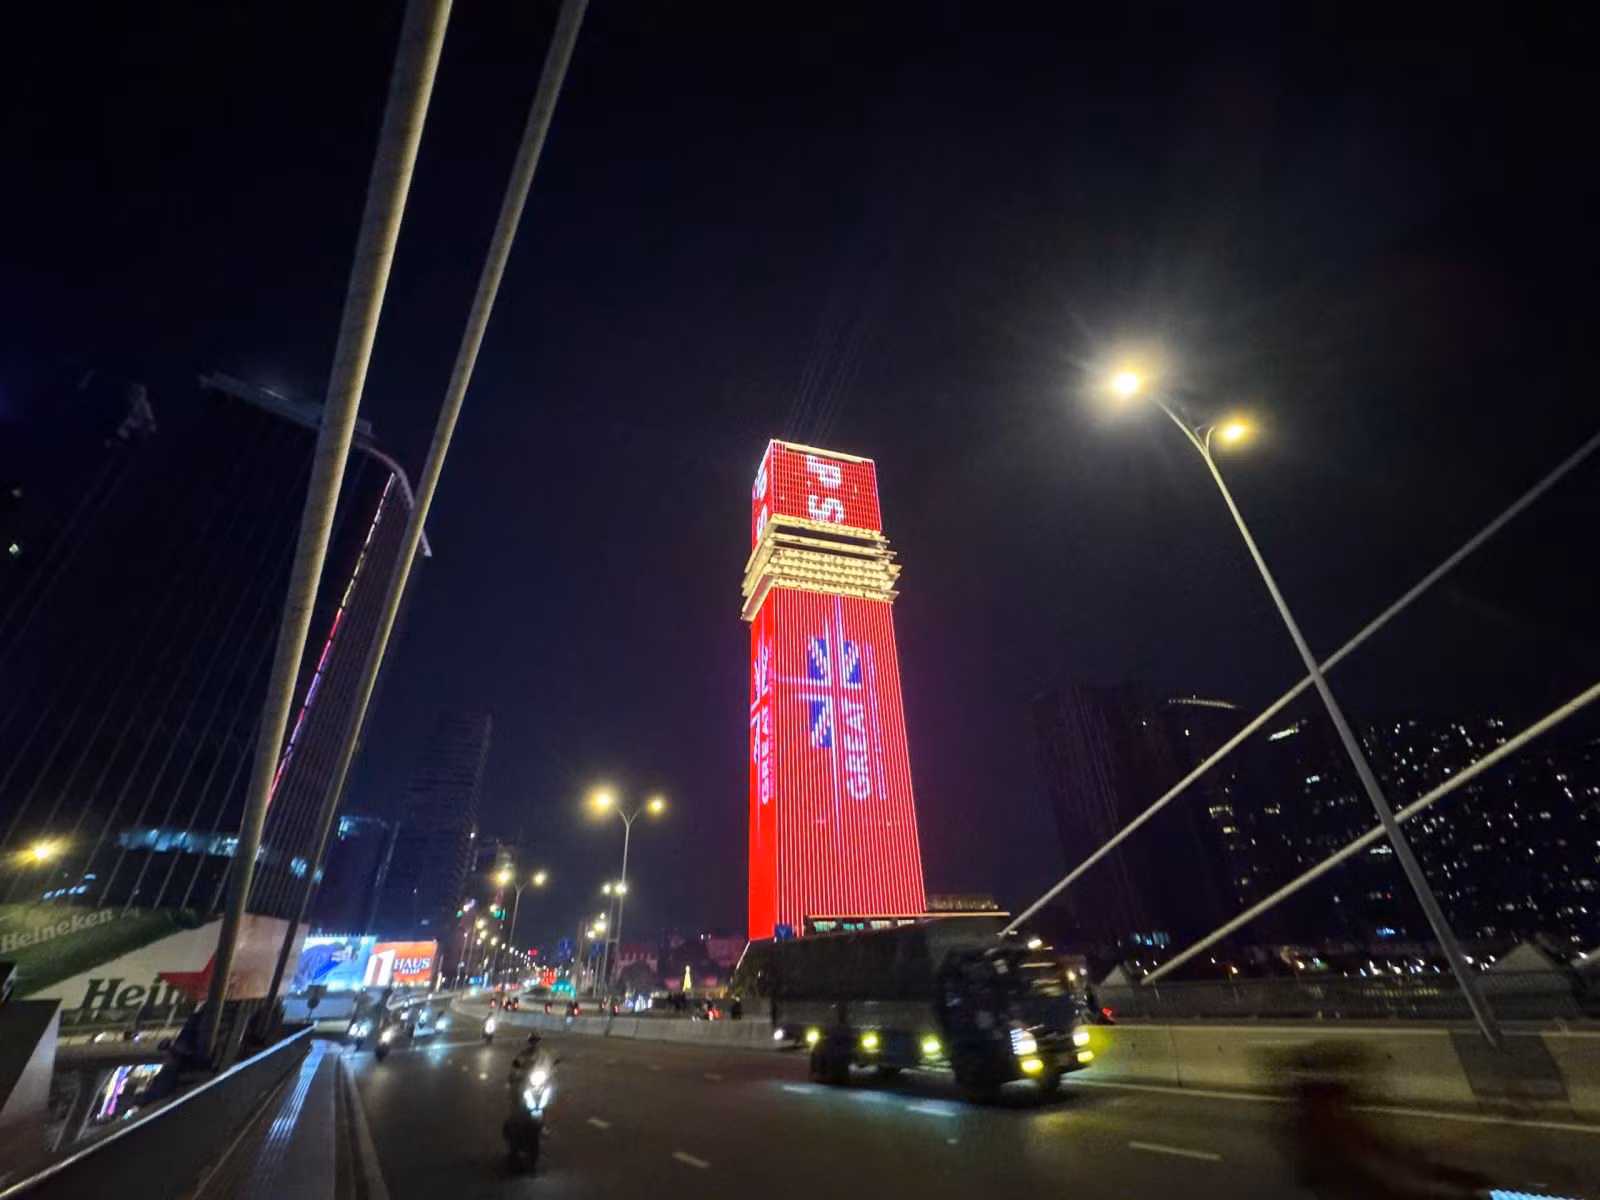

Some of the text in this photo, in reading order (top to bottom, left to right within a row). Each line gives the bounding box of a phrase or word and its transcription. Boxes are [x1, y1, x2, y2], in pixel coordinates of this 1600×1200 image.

[841, 697, 871, 800] GREAT
[1, 908, 113, 952] Heineken
[394, 957, 430, 969] HAUS
